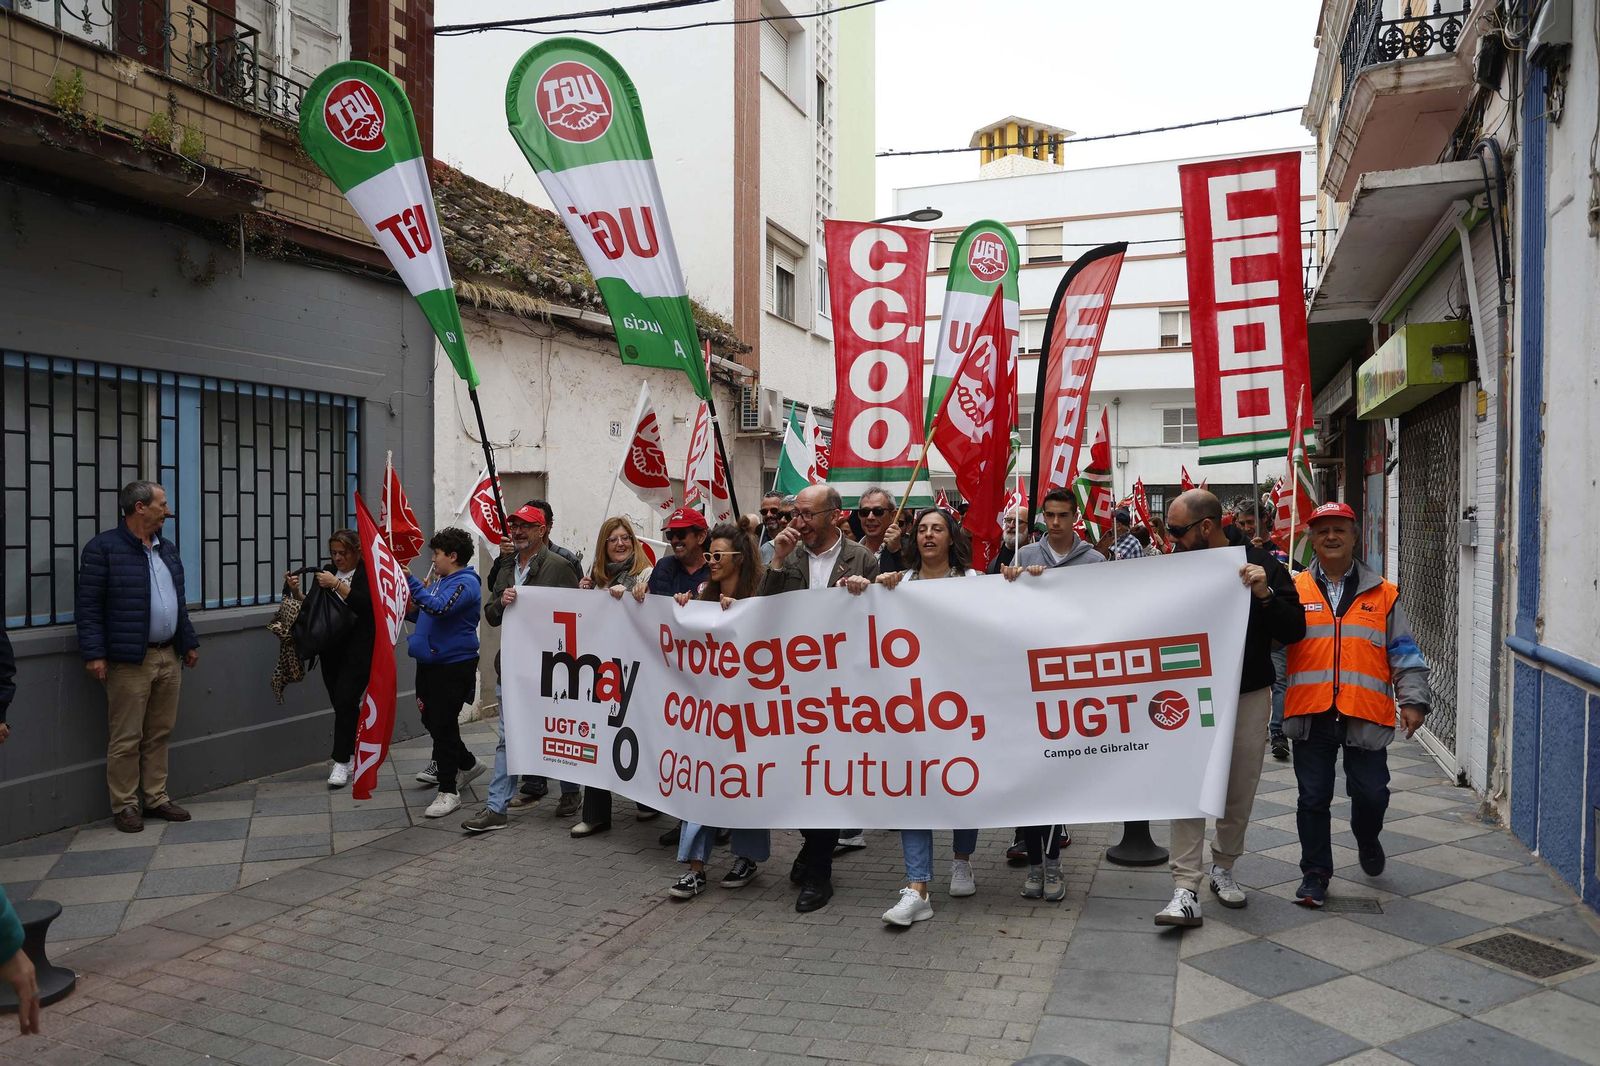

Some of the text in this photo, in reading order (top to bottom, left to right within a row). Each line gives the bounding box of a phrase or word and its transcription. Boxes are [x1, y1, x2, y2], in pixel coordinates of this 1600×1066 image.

[972, 239, 1004, 262] UGT
[660, 614, 921, 690] Proteger lo
[1036, 647, 1153, 683] CCOO
[544, 716, 577, 735] UGT
[663, 677, 987, 753] conquistado,
[1036, 694, 1138, 740] UGT
[545, 740, 581, 757] CCOO
[1043, 741, 1149, 759] Campo de Gibraltar
[658, 743, 980, 799] ganar futuro
